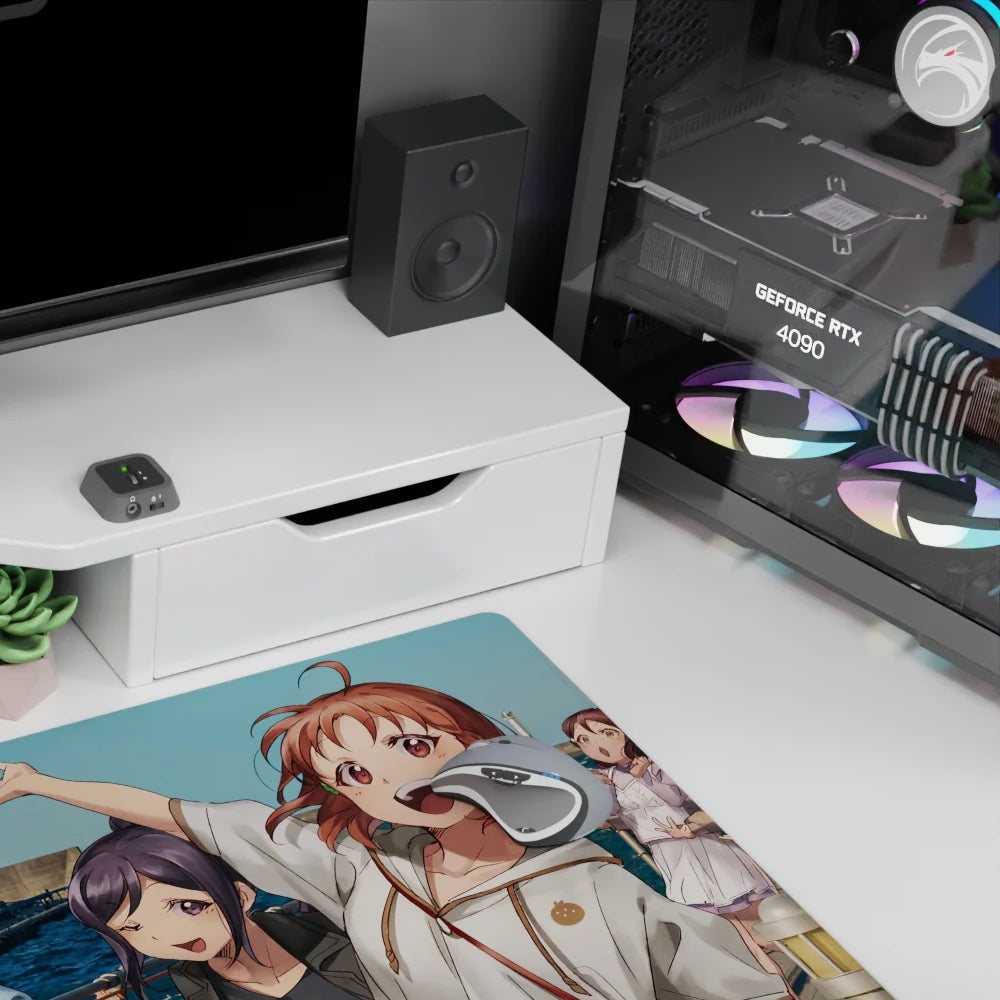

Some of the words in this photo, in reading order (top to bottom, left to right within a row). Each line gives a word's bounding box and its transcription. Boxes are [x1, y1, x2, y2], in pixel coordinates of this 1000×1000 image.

[755, 282, 826, 329] GEFORCE
[828, 317, 862, 347] RTX
[776, 325, 825, 360] 4090
